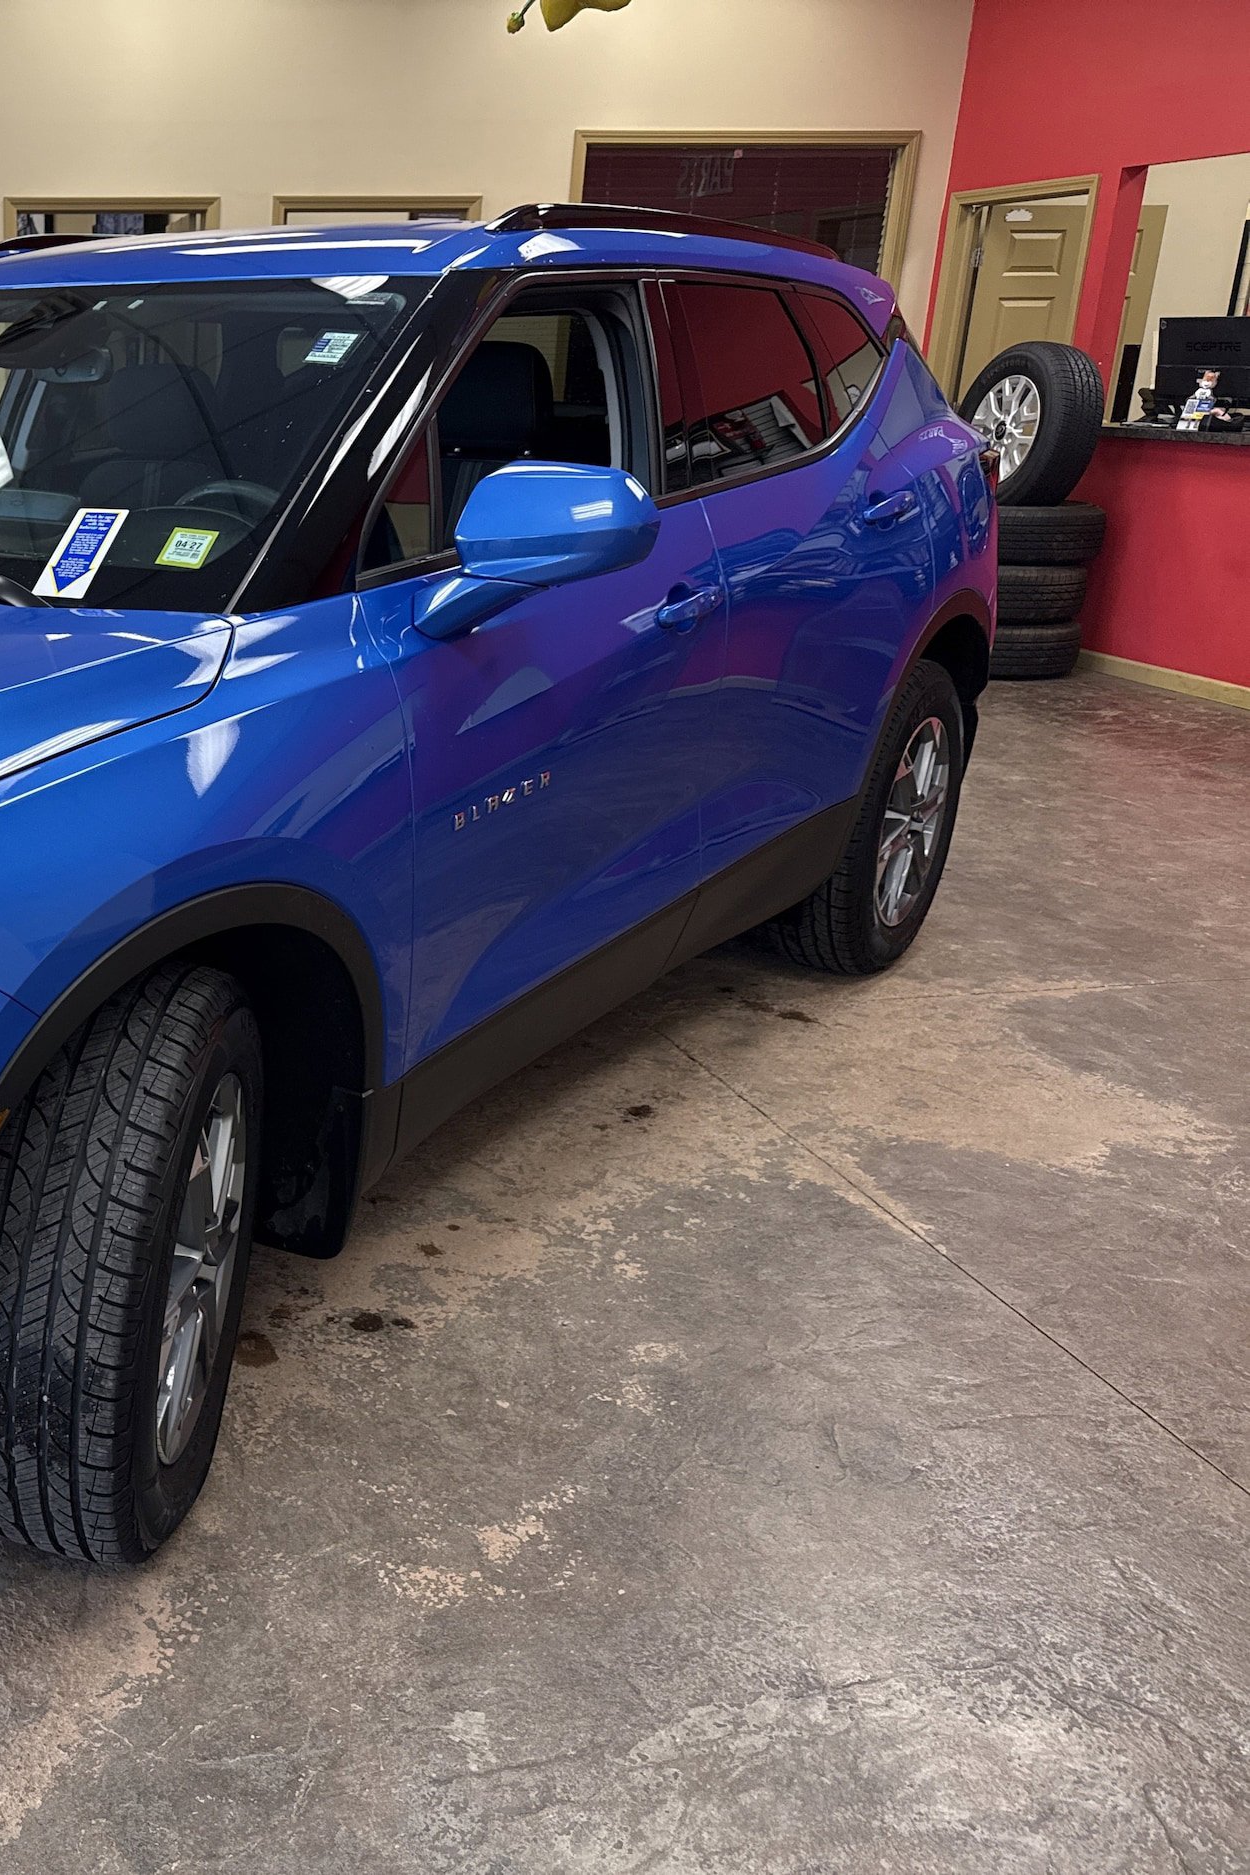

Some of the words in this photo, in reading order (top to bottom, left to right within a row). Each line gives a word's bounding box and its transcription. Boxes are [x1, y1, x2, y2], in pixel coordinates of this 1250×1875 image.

[175, 540, 188, 548] 04
[189, 541, 203, 550] 27
[454, 770, 551, 832] BLAZER
